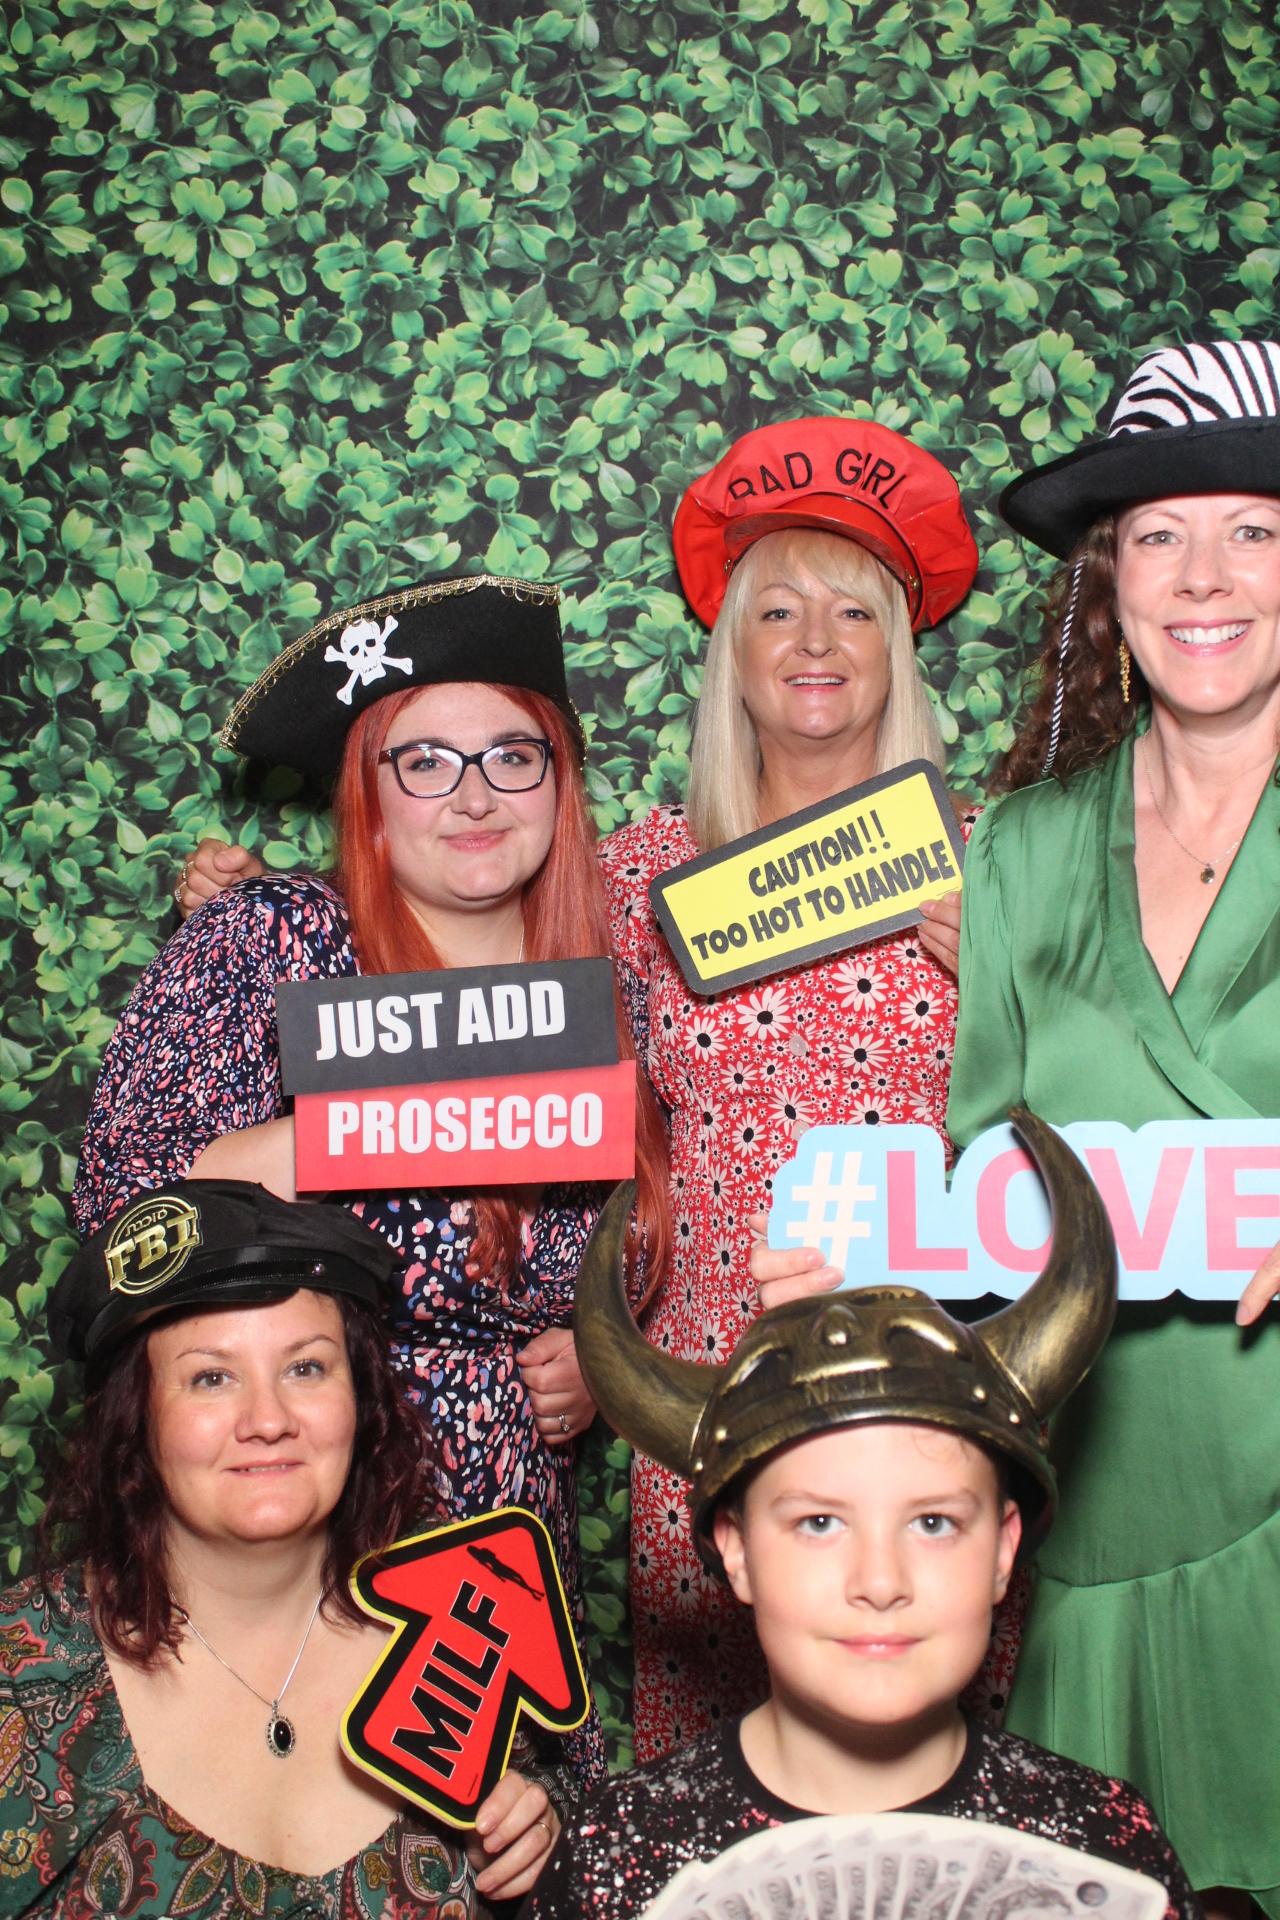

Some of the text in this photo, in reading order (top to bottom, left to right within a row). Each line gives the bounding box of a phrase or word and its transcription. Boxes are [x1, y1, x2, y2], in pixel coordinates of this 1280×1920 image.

[835, 448, 906, 510] GIRL
[748, 809, 892, 897] CAUTION!!
[690, 840, 956, 960] TOO HOT TO HANDLE
[316, 980, 565, 1061] JUST ADD
[328, 1092, 603, 1156] PROSECCO
[104, 1207, 199, 1291] FBI
[390, 1579, 511, 1780] MILF
